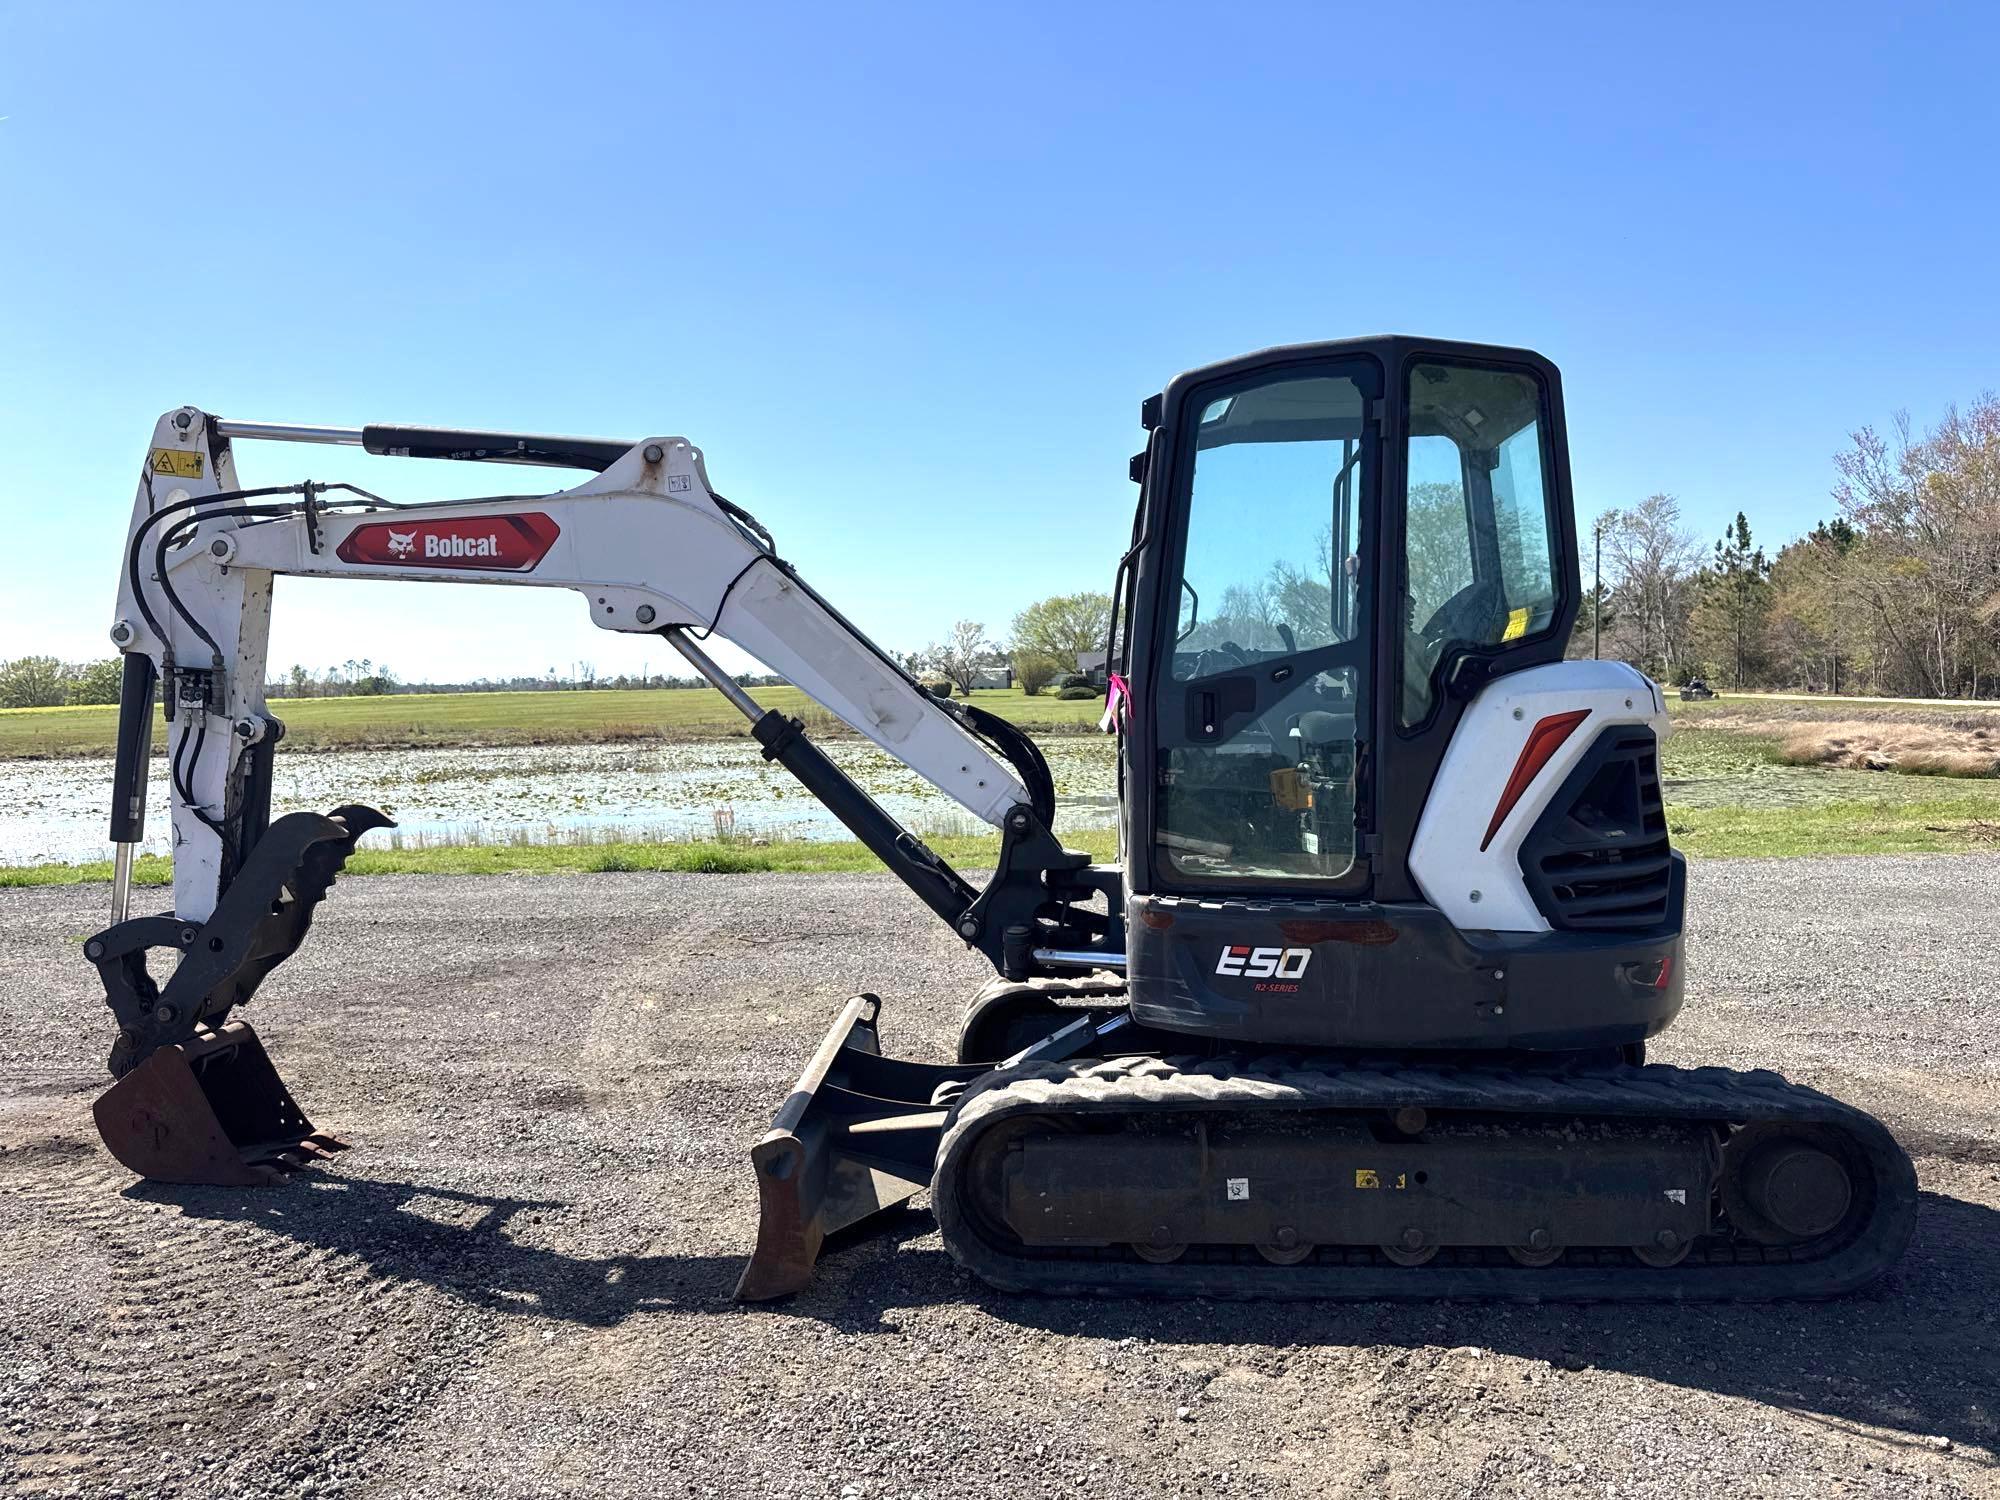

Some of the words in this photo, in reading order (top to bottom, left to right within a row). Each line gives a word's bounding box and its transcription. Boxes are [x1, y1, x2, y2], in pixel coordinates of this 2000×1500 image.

[425, 534, 497, 557] Bobcat
[1215, 945, 1312, 979] E50
[1254, 983, 1299, 993] R2-SERIES
